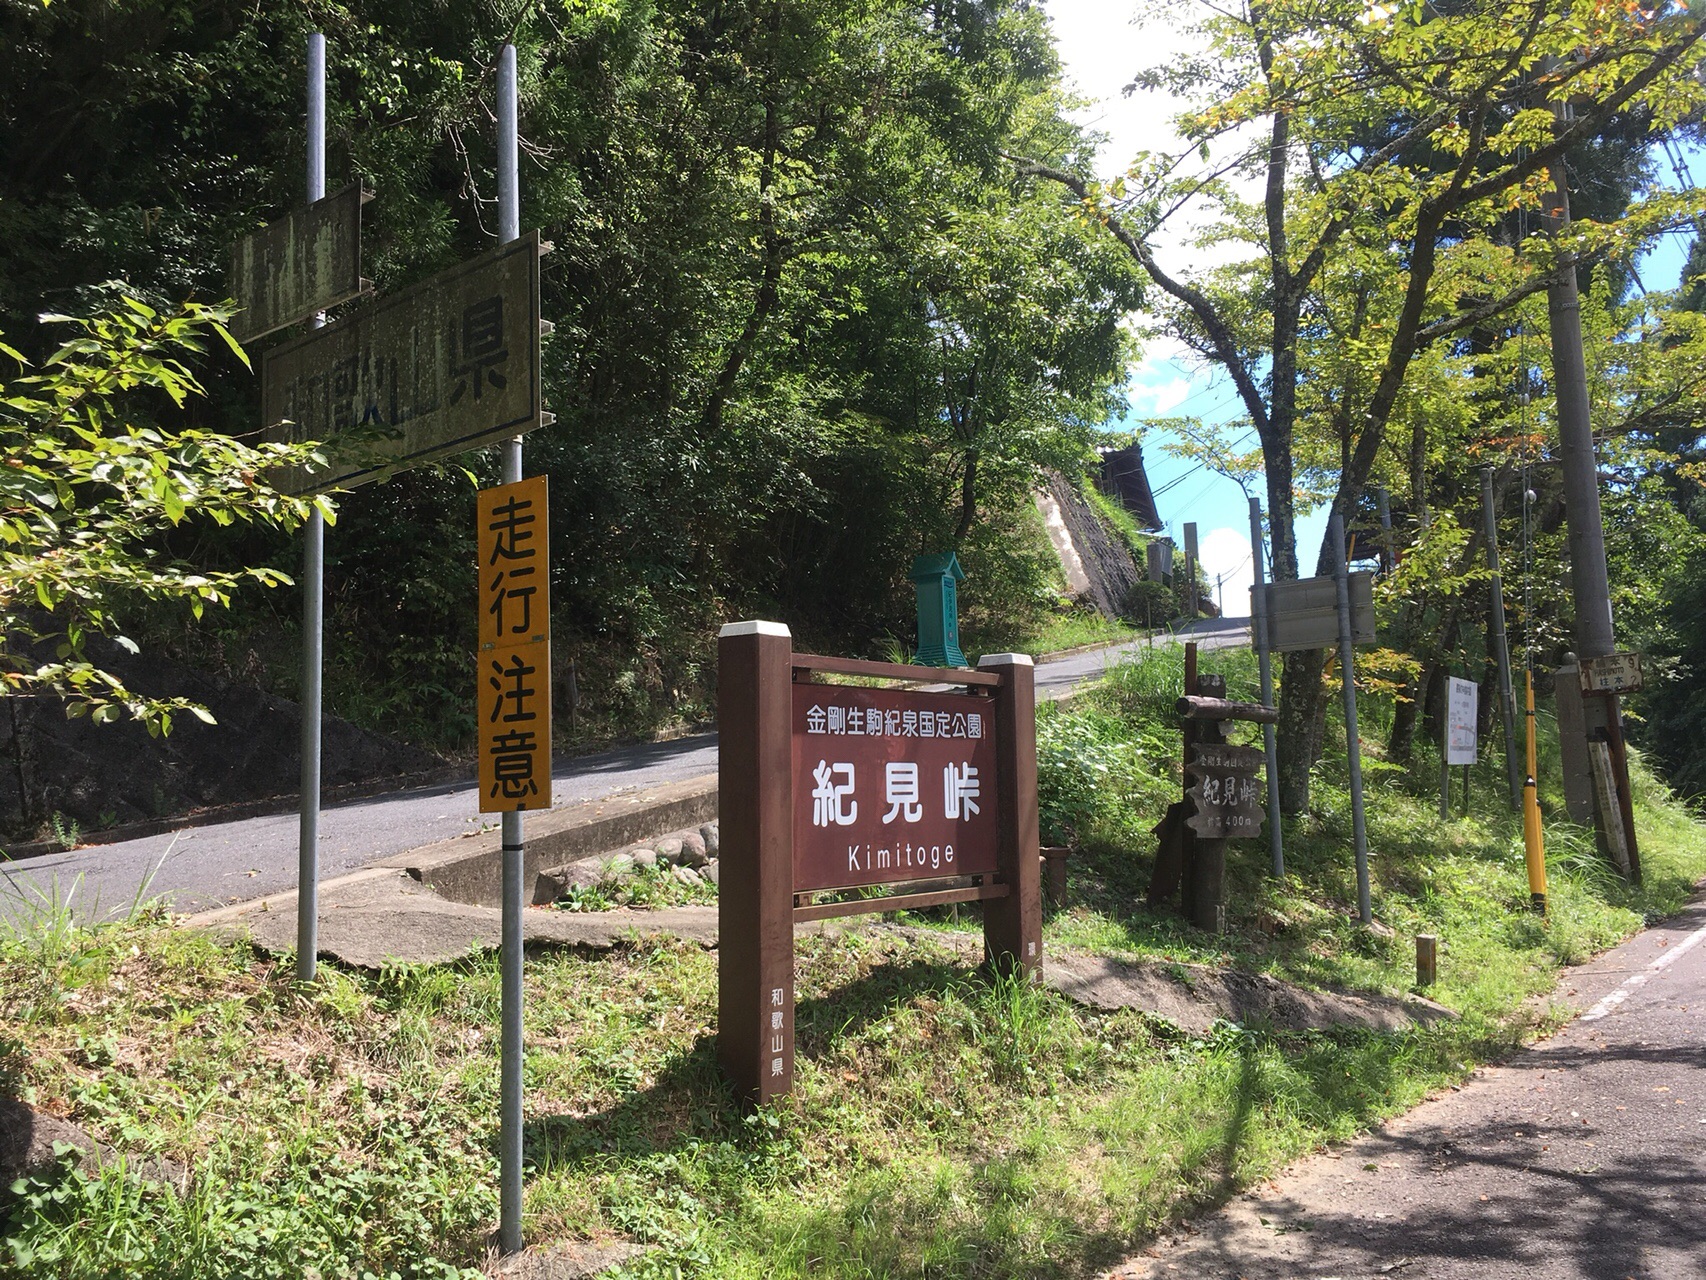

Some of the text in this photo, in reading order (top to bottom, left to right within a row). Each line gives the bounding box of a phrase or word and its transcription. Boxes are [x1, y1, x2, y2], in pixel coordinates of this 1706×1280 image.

[488, 496, 538, 799] 走行注意
[806, 704, 982, 739] 金剛生駒紀泉国定公園
[812, 759, 980, 828] 紀見峠
[1203, 775, 1258, 809] 紀見峠
[848, 842, 955, 872] Kimitoge
[771, 988, 784, 1077] 和歌山県
